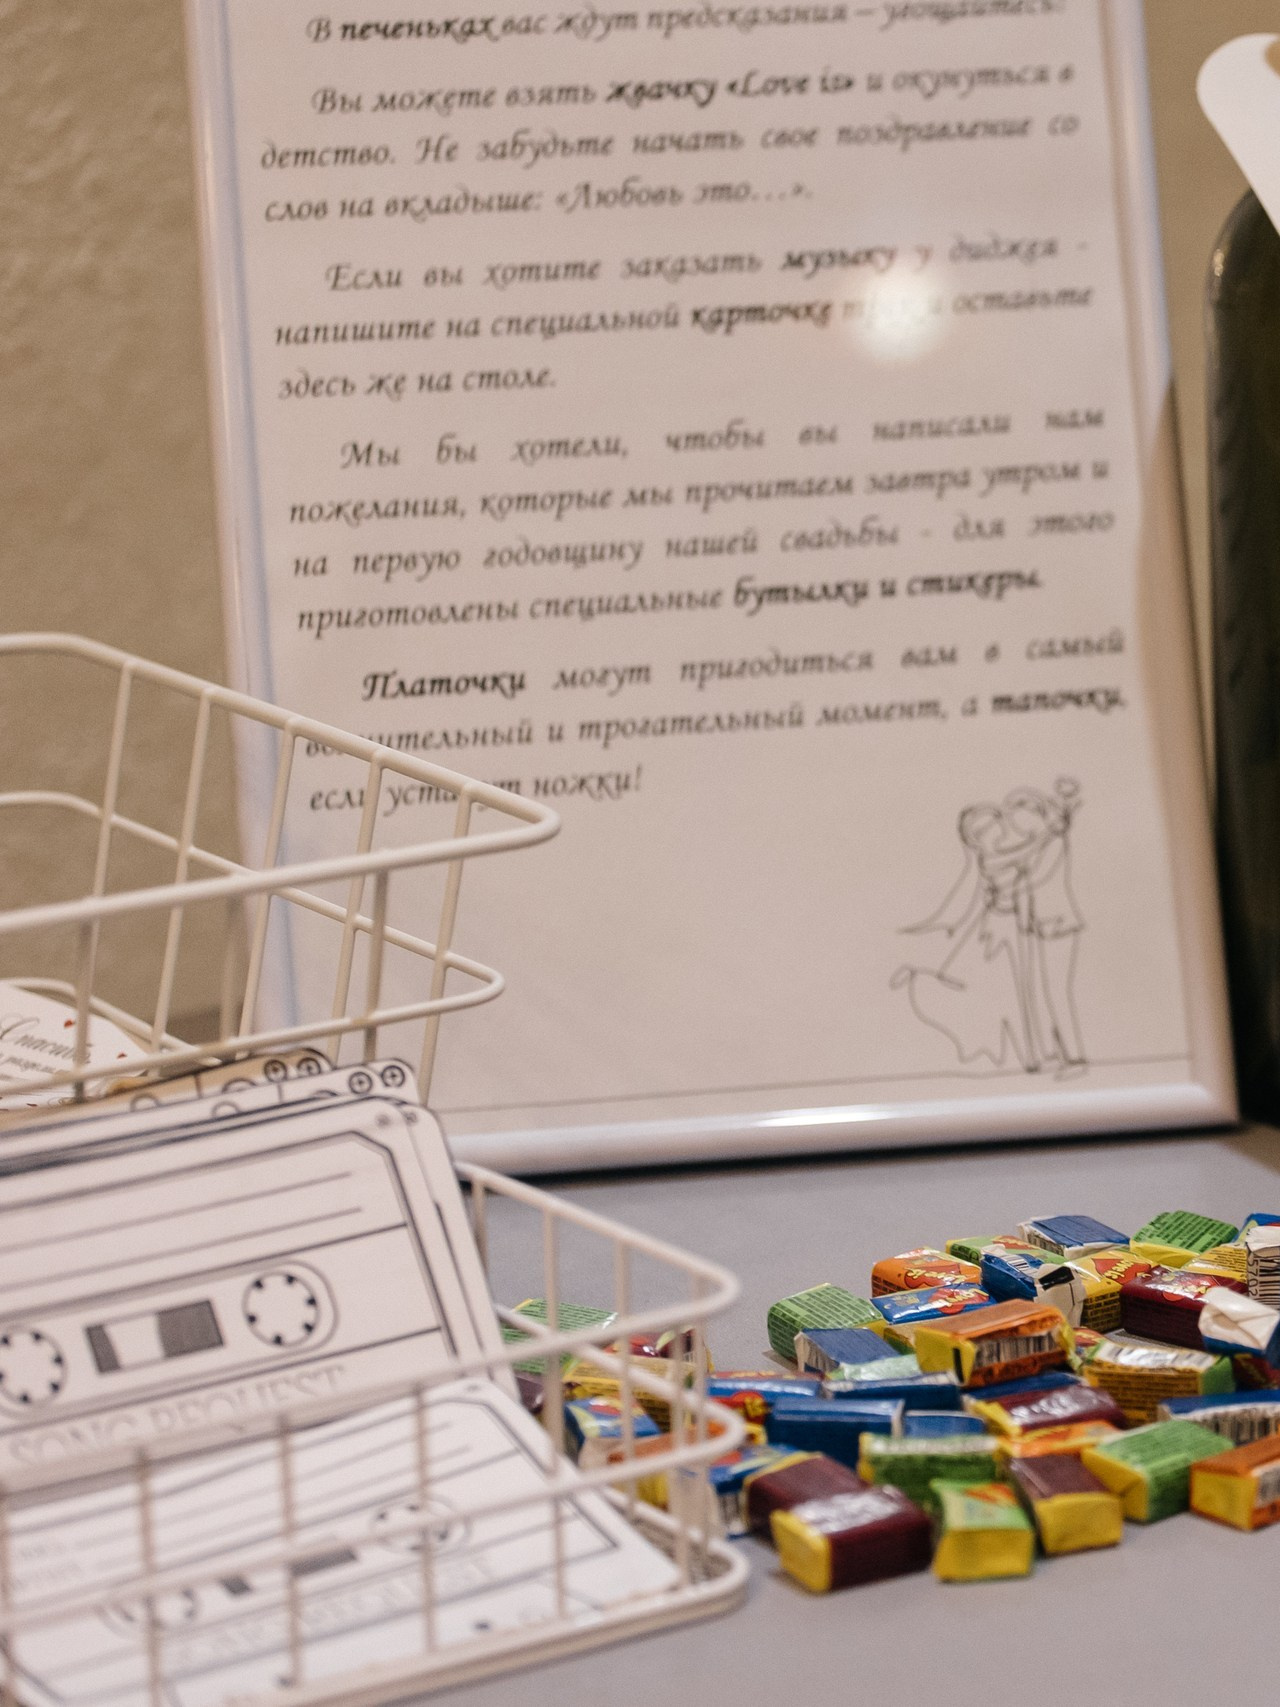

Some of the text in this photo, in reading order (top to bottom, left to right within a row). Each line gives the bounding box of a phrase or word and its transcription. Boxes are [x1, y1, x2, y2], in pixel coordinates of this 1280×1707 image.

[307, 17, 331, 42] В
[340, 15, 499, 43] печеньках
[501, 14, 547, 35] вас
[554, 3, 638, 42] ждут
[647, 1, 848, 40] предсказания
[311, 88, 361, 114] Вы
[372, 84, 495, 117] можете
[505, 79, 597, 109] взять
[606, 75, 716, 107] жвачку
[866, 72, 884, 93] и
[893, 64, 1050, 99] окунуться
[1058, 63, 1075, 83] в
[260, 113, 1081, 169] детство. Не забудьте начать свое поздравление со
[264, 199, 328, 223] слов
[339, 197, 374, 219] на
[384, 184, 543, 224] вкладыше:
[555, 175, 684, 213] «Любовь
[325, 262, 402, 291] Если
[424, 265, 463, 286] вы
[482, 258, 601, 291] хотите
[621, 251, 763, 284] заказать
[779, 245, 898, 280] музыку
[948, 230, 1059, 266] диджея
[275, 318, 434, 346] напишите
[446, 315, 480, 338] на
[491, 303, 680, 339] специальной
[691, 300, 832, 335] карточке
[951, 286, 1094, 315] оставьте
[278, 366, 556, 402] здесь же на столе.
[340, 406, 1105, 469] Мы бы хотели, чтобы вы написали нам
[290, 457, 1110, 527] пожелания, которые мы прочитаем завтра утром и
[293, 554, 329, 577] на
[352, 548, 462, 583] первую
[482, 534, 645, 571] годовщину
[665, 528, 759, 560] нашей
[780, 514, 901, 554] свадьбы
[953, 511, 1006, 542] для
[1027, 511, 1115, 540] этого
[298, 600, 520, 639] приготовлены
[529, 586, 723, 625] специальные
[733, 574, 869, 616] бутылки
[878, 578, 897, 599] и
[361, 626, 1126, 702] Платочки могут пригодиться вам в самый
[306, 717, 534, 757] вительный
[547, 722, 565, 745] и
[578, 701, 804, 748] трогательный
[815, 695, 948, 727] момент,
[961, 694, 979, 718] а
[384, 778, 523, 817] устат
[534, 764, 643, 801] ножки!
